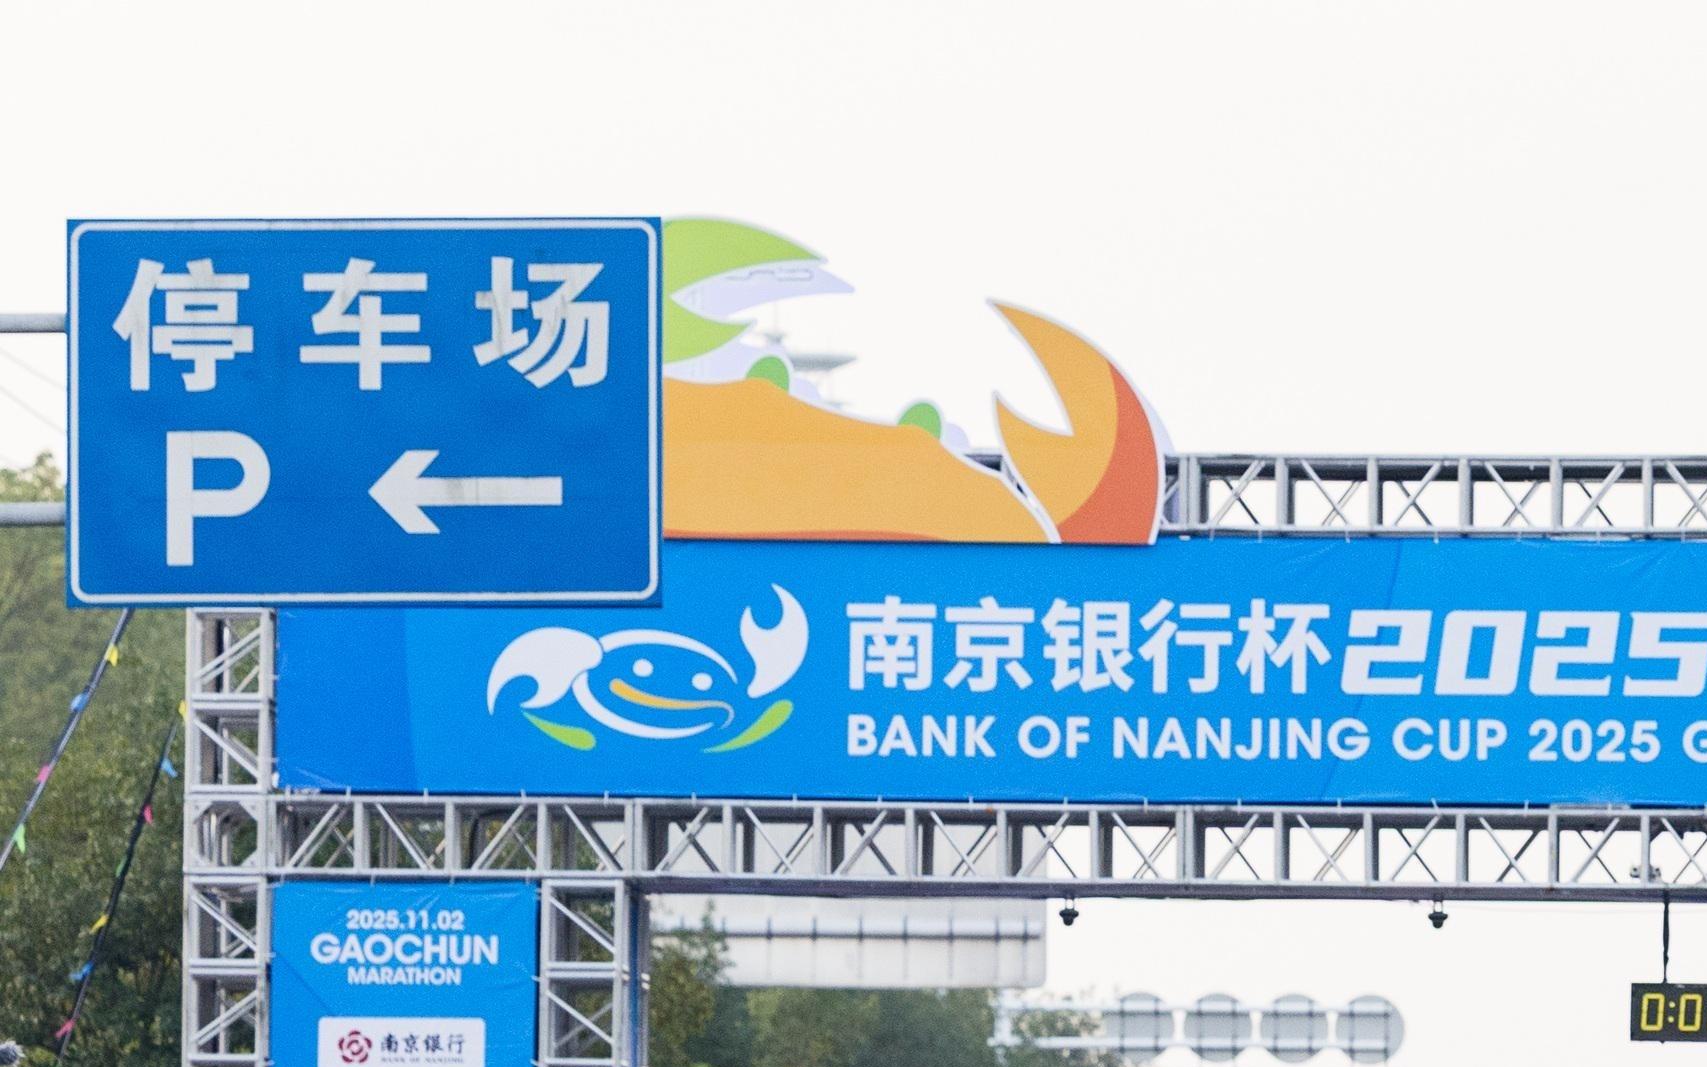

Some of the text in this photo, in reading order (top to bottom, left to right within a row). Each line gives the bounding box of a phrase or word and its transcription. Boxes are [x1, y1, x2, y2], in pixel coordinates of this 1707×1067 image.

[113, 257, 609, 392] 停车场
[166, 431, 271, 566] P
[847, 714, 998, 759] BANK
[1017, 715, 1090, 760] OF
[1112, 717, 1371, 762] NANJING
[1392, 718, 1507, 762] CUP
[1529, 720, 1660, 763] 2025
[346, 910, 464, 930] 2025.11.02
[310, 933, 499, 965] GAOCHUN
[347, 967, 461, 985] MARATHON
[380, 1033, 467, 1054] 南京银行
